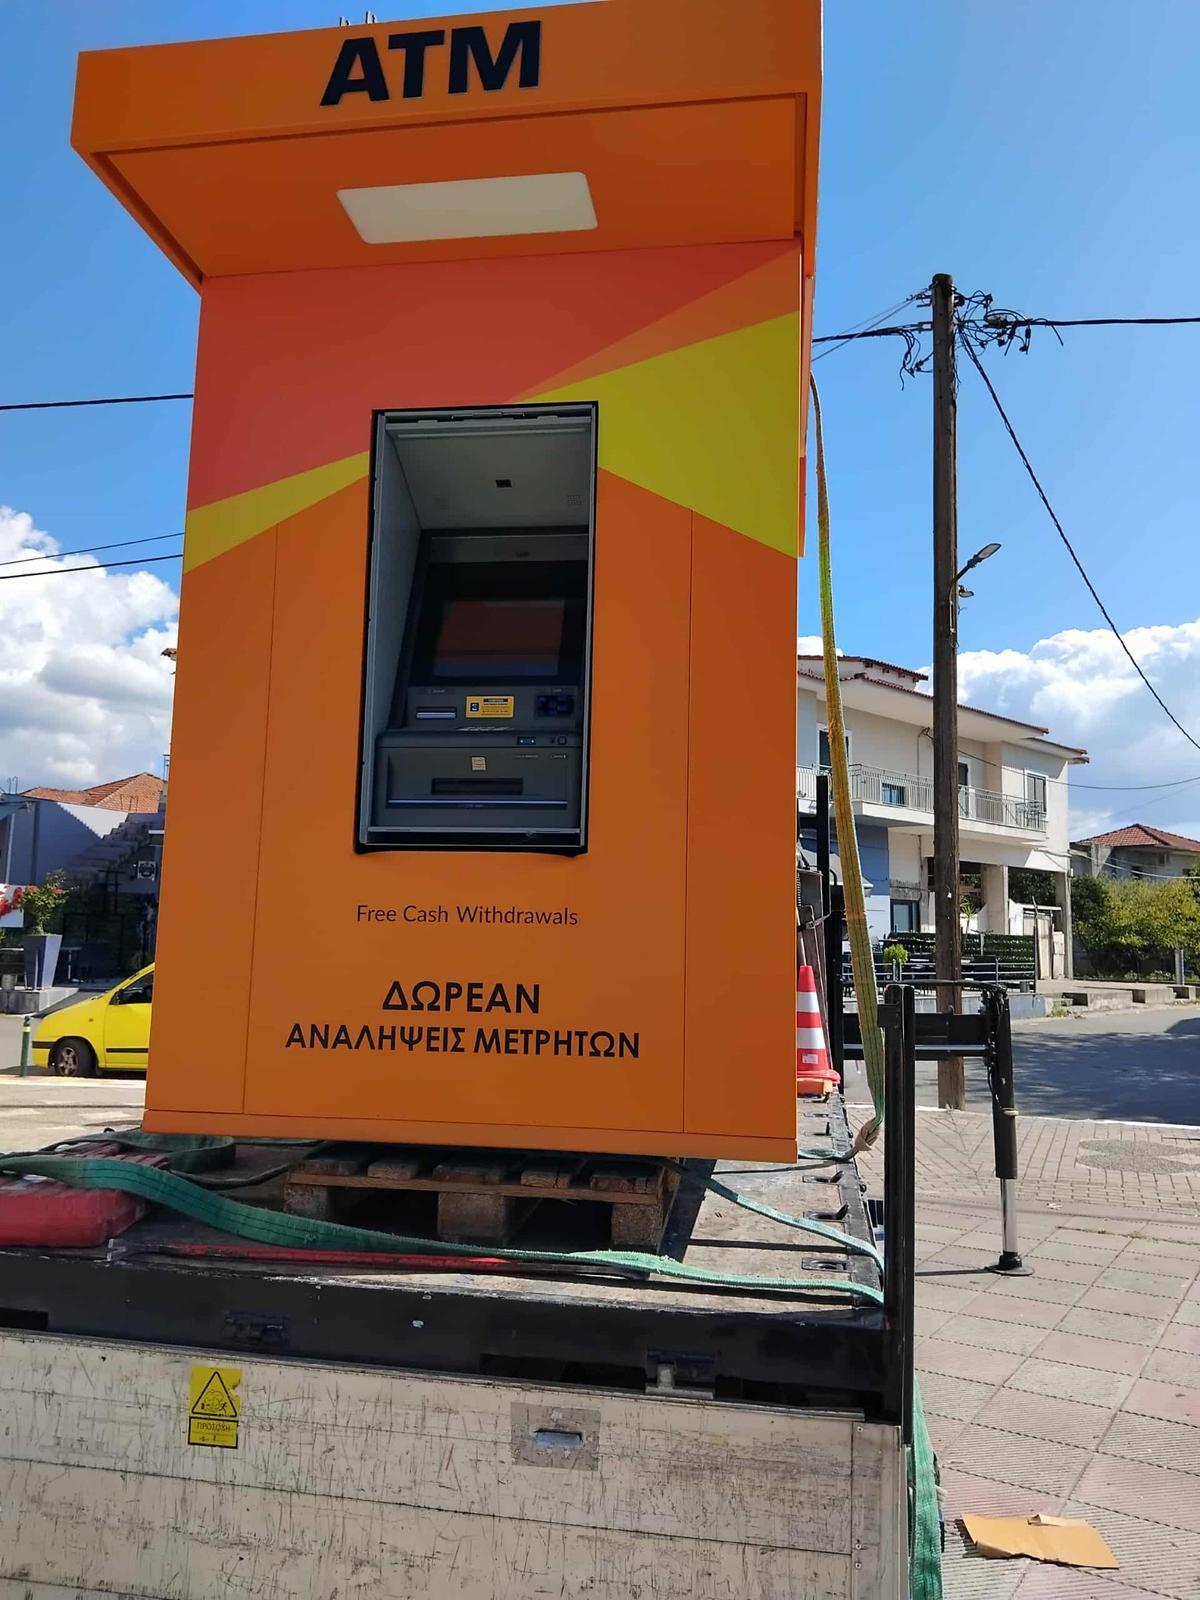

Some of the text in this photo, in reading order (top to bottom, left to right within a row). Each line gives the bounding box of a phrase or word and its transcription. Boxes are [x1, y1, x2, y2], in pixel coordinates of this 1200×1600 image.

[320, 21, 541, 107] ATM
[357, 905, 578, 926] Free Cash Withdrawals
[383, 981, 540, 1014] ΔΩΡΕΑΝ
[285, 1024, 640, 1058] ΑΝΑΛΗΨΕΙΣ ΜΕΤΡΗΤΩΝ
